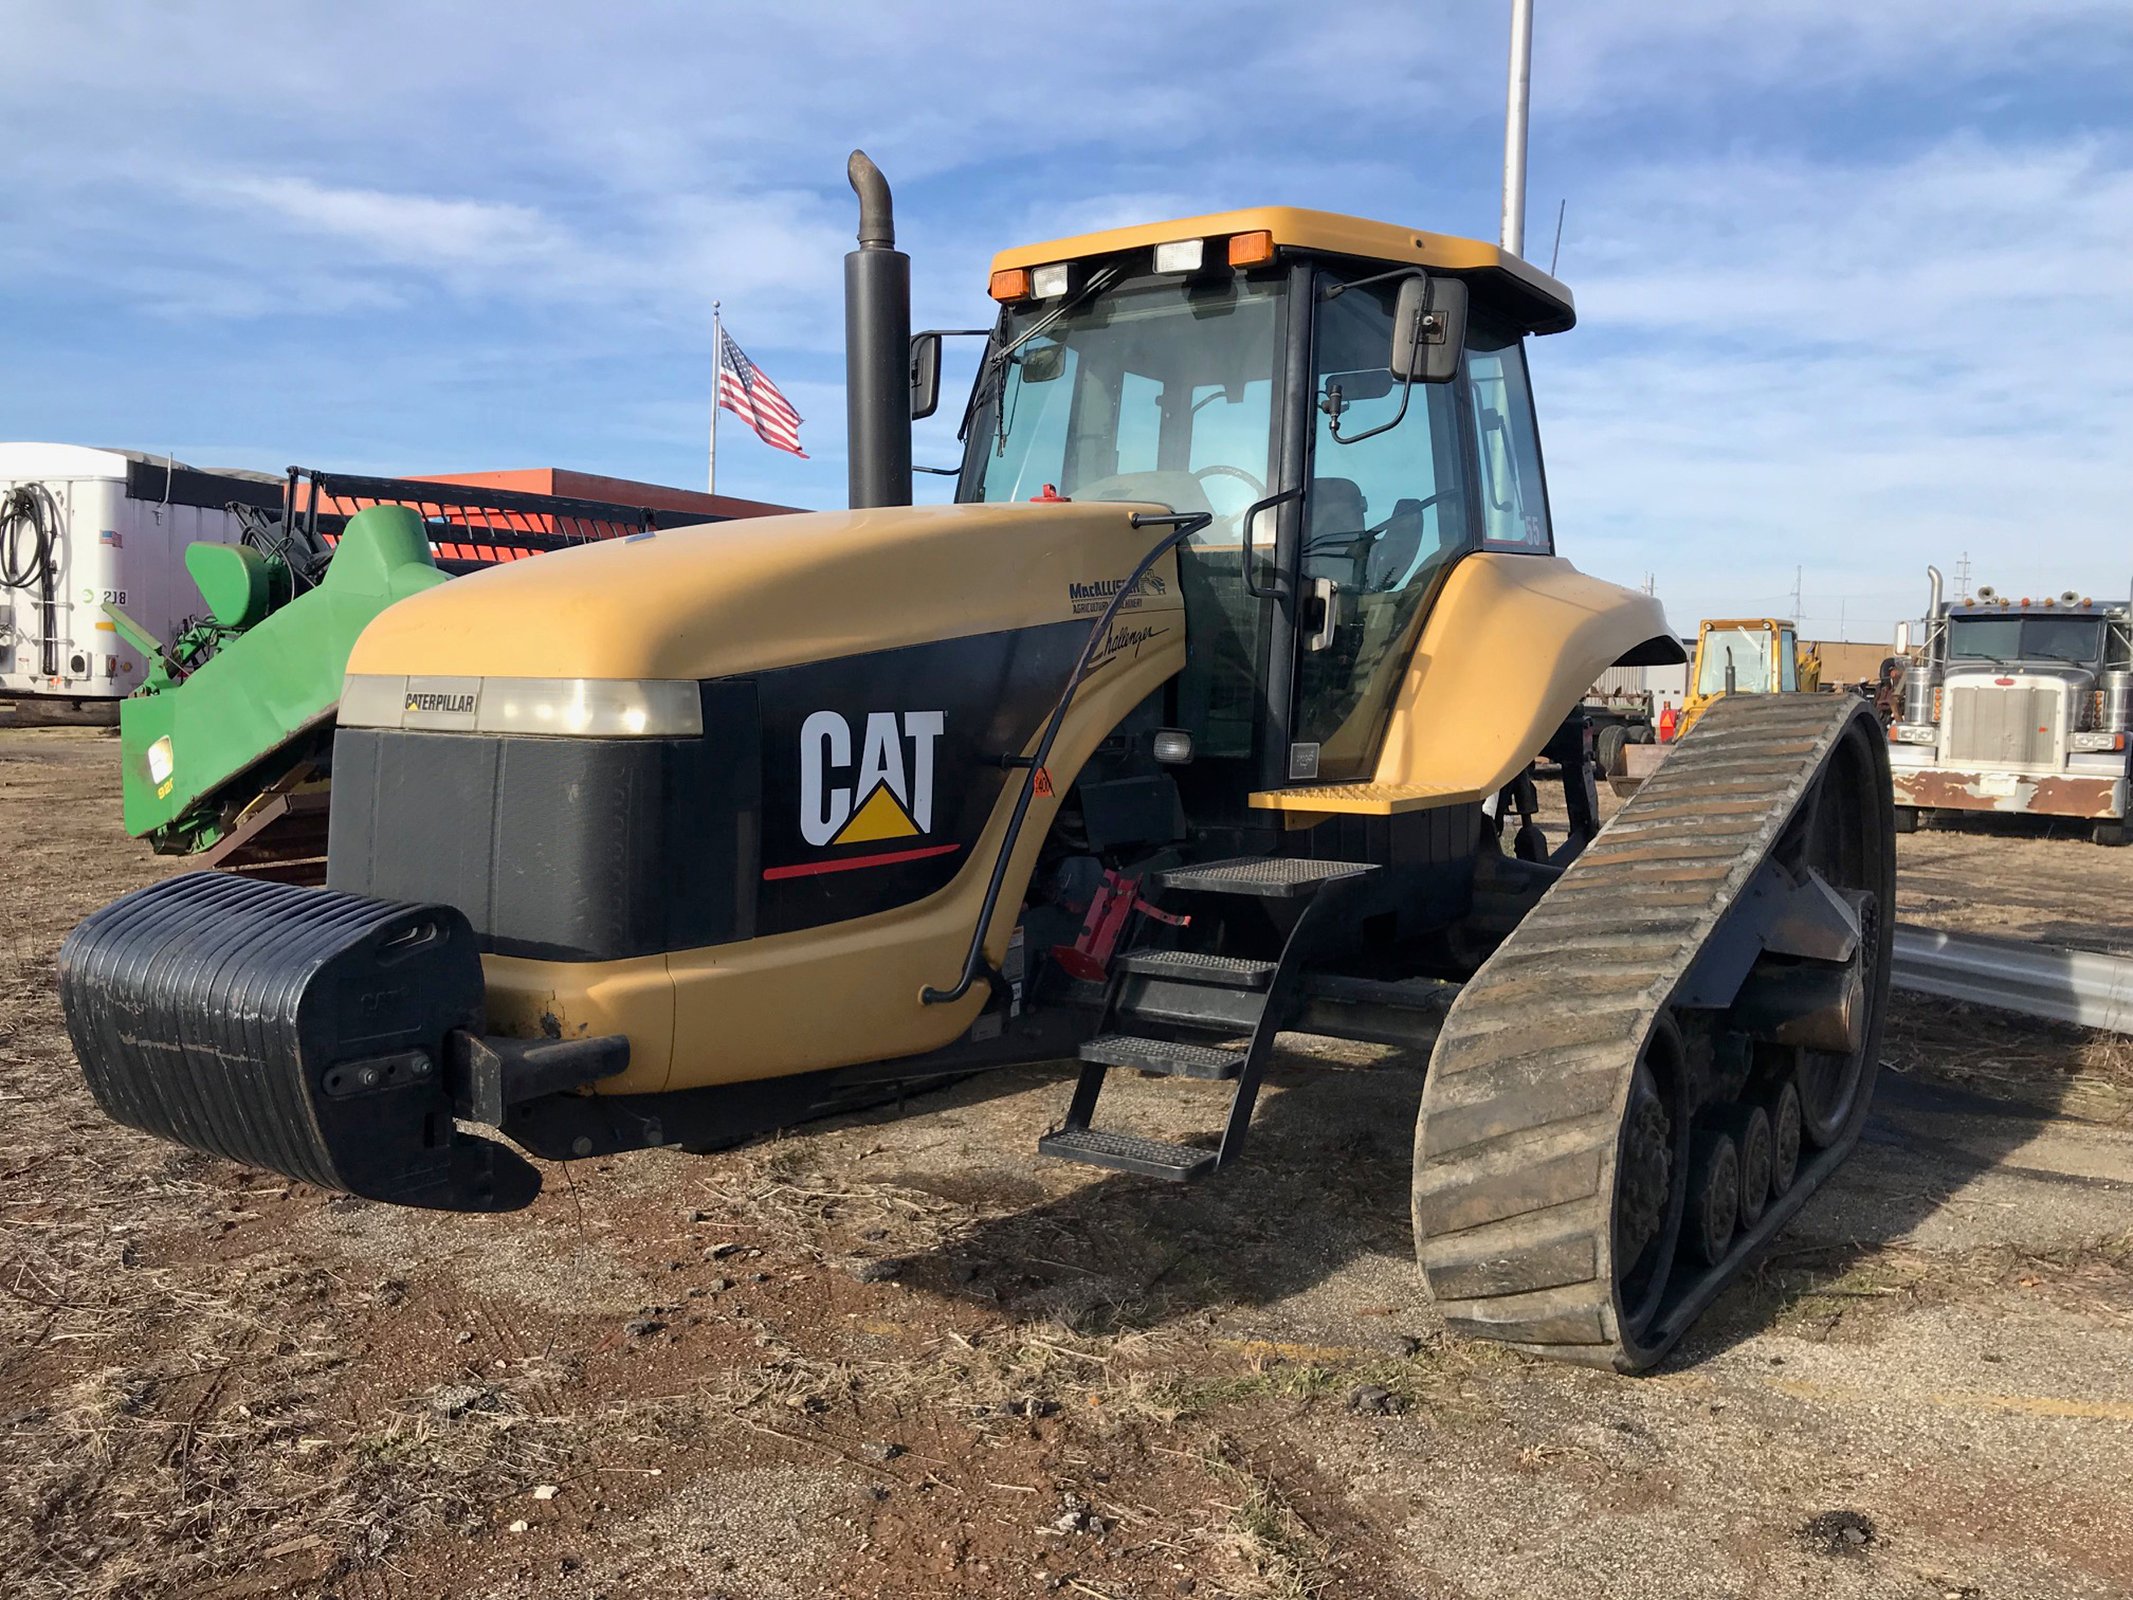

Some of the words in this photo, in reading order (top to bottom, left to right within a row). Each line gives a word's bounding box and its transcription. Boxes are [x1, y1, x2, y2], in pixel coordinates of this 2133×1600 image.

[103, 590, 126, 605] 218
[405, 693, 474, 713] CATERPILLAR
[800, 710, 945, 847] CAT
